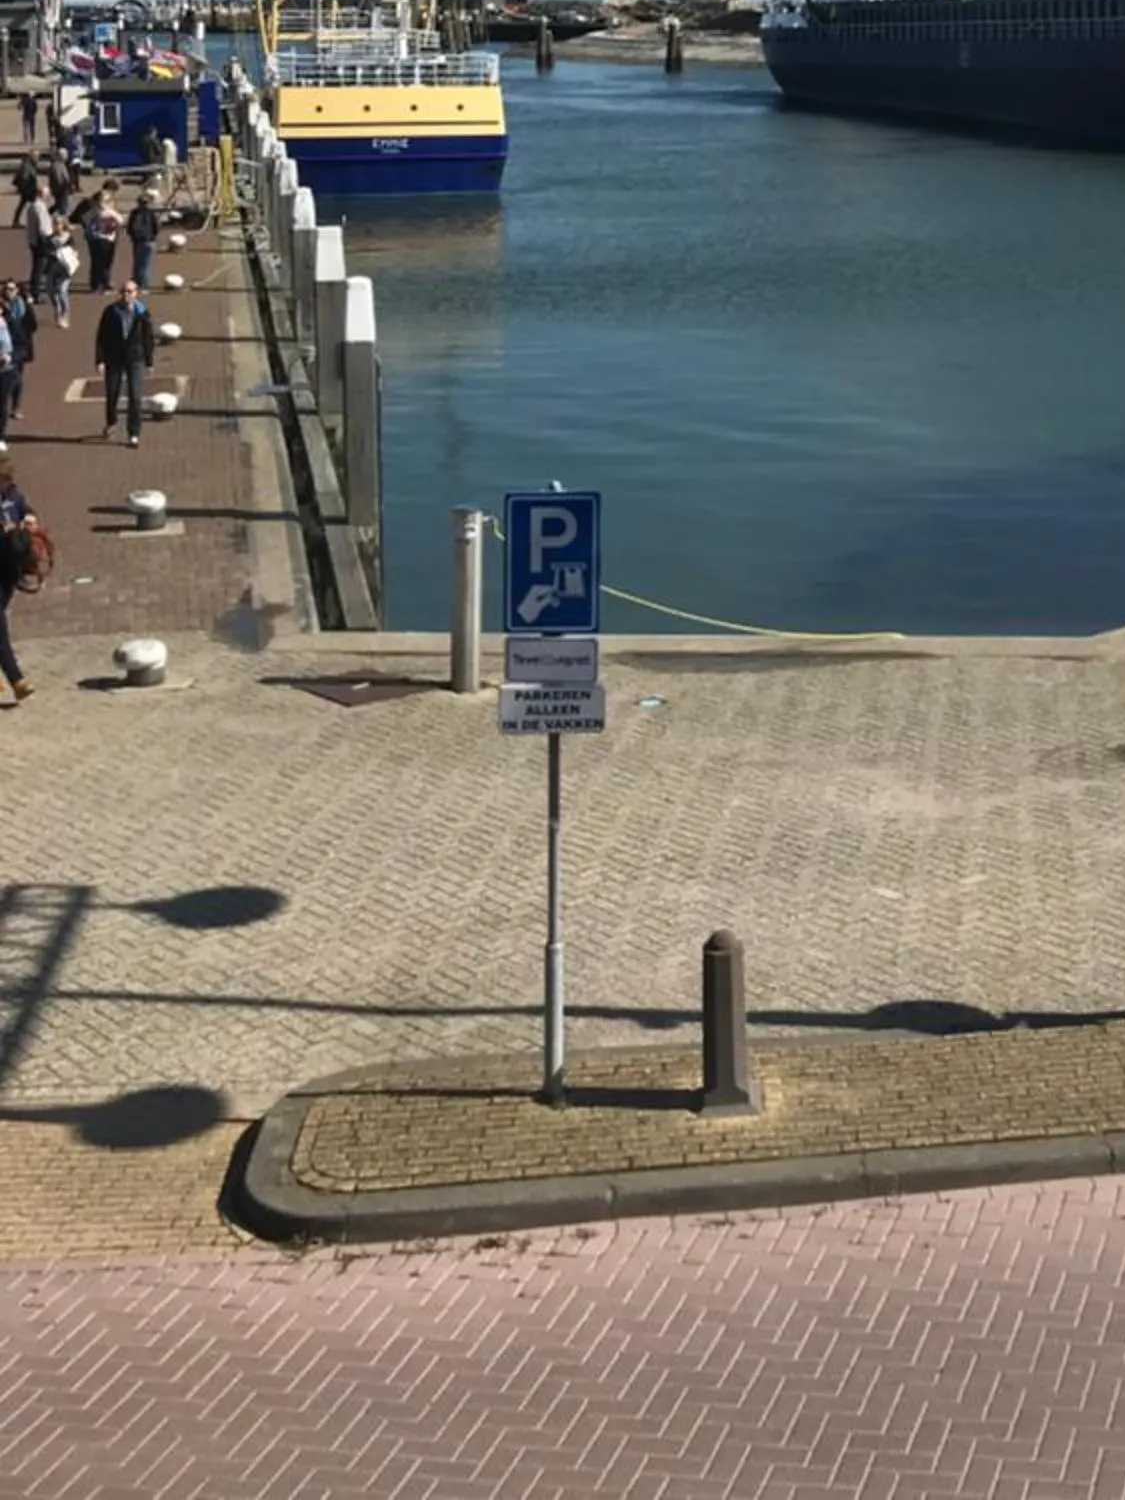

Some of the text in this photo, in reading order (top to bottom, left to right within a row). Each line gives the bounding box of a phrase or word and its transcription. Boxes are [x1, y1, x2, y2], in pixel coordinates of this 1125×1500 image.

[529, 505, 578, 574] P
[514, 690, 592, 701] PARKEREN
[525, 704, 581, 715] ALLEEN
[521, 719, 540, 730] DE
[544, 718, 605, 730] VAKKEN
